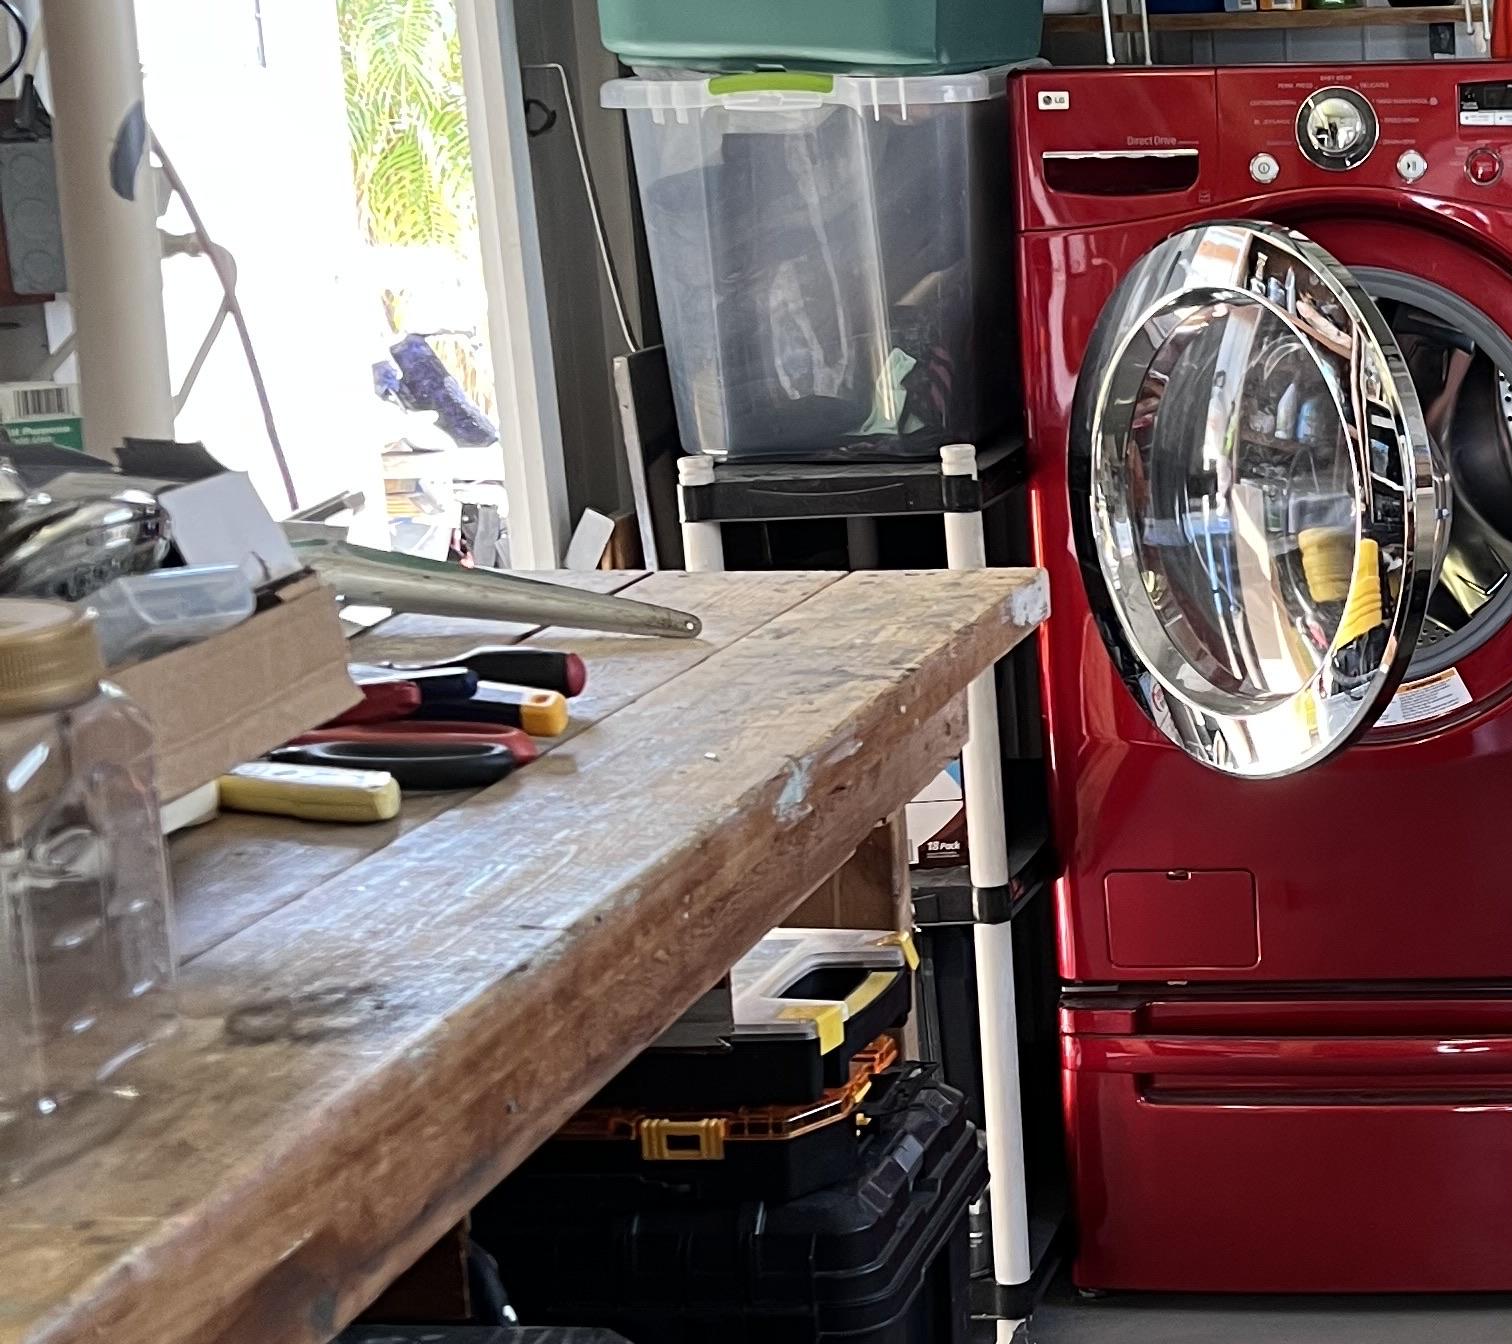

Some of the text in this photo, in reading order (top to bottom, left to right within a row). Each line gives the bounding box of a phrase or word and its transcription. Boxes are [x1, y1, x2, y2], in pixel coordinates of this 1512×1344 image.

[1127, 135, 1177, 146] Direct Drive
[940, 840, 961, 850] Pack
